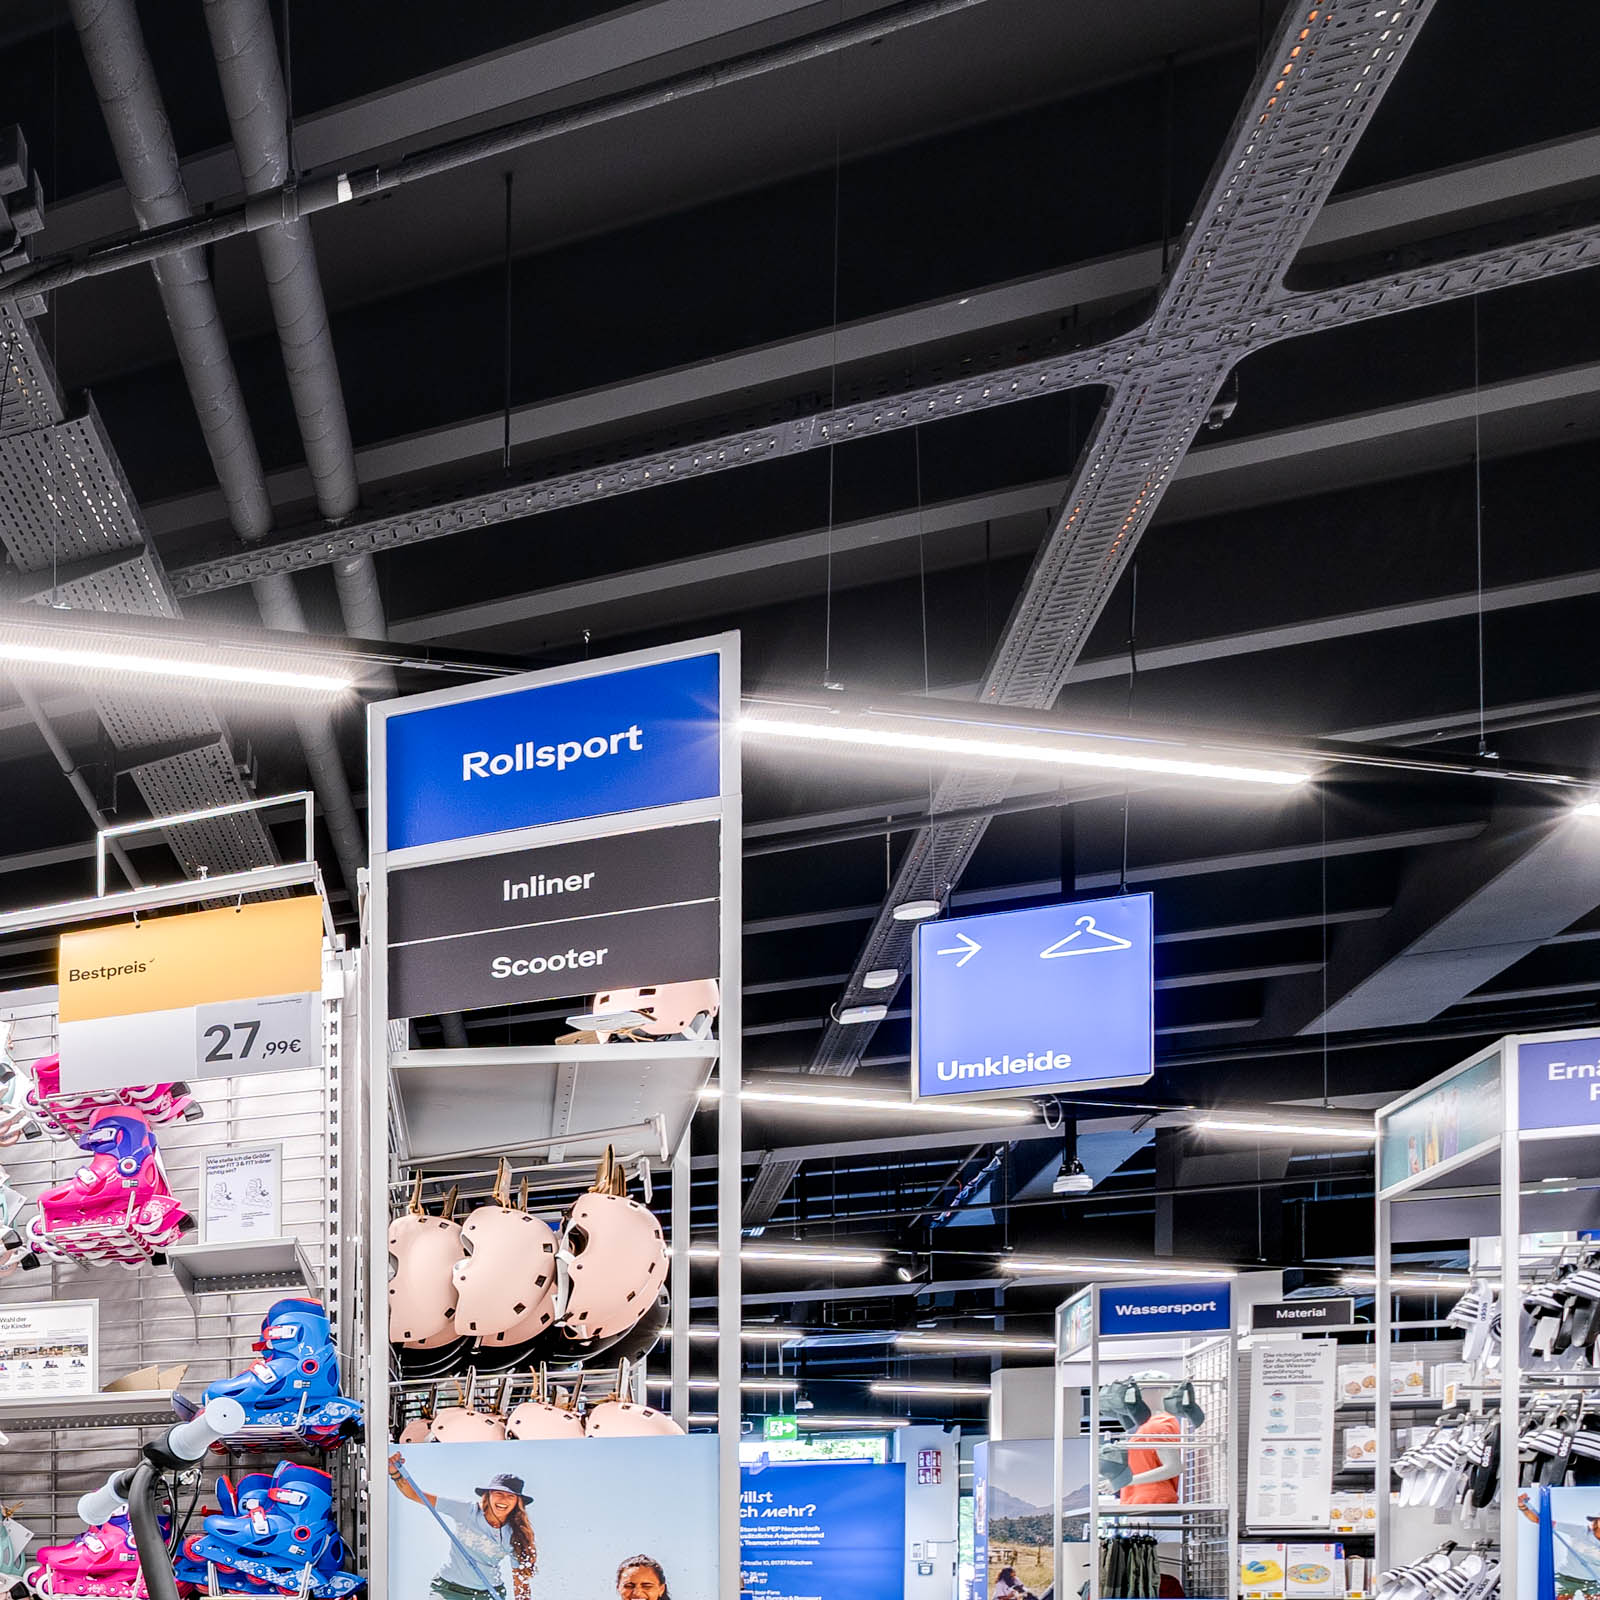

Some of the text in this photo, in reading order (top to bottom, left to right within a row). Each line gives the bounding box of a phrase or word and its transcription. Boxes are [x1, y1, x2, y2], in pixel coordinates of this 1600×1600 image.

[462, 724, 643, 782] Rollsport
[503, 872, 595, 902] Inliner
[69, 961, 147, 982] Bestpreis
[491, 947, 609, 979] Scooter
[204, 1020, 302, 1062] 27,99€
[937, 1051, 1072, 1082] Umkleide
[1116, 1301, 1217, 1316] Wassersport
[1276, 1308, 1326, 1319] Material
[761, 1504, 816, 1518] mehr?
